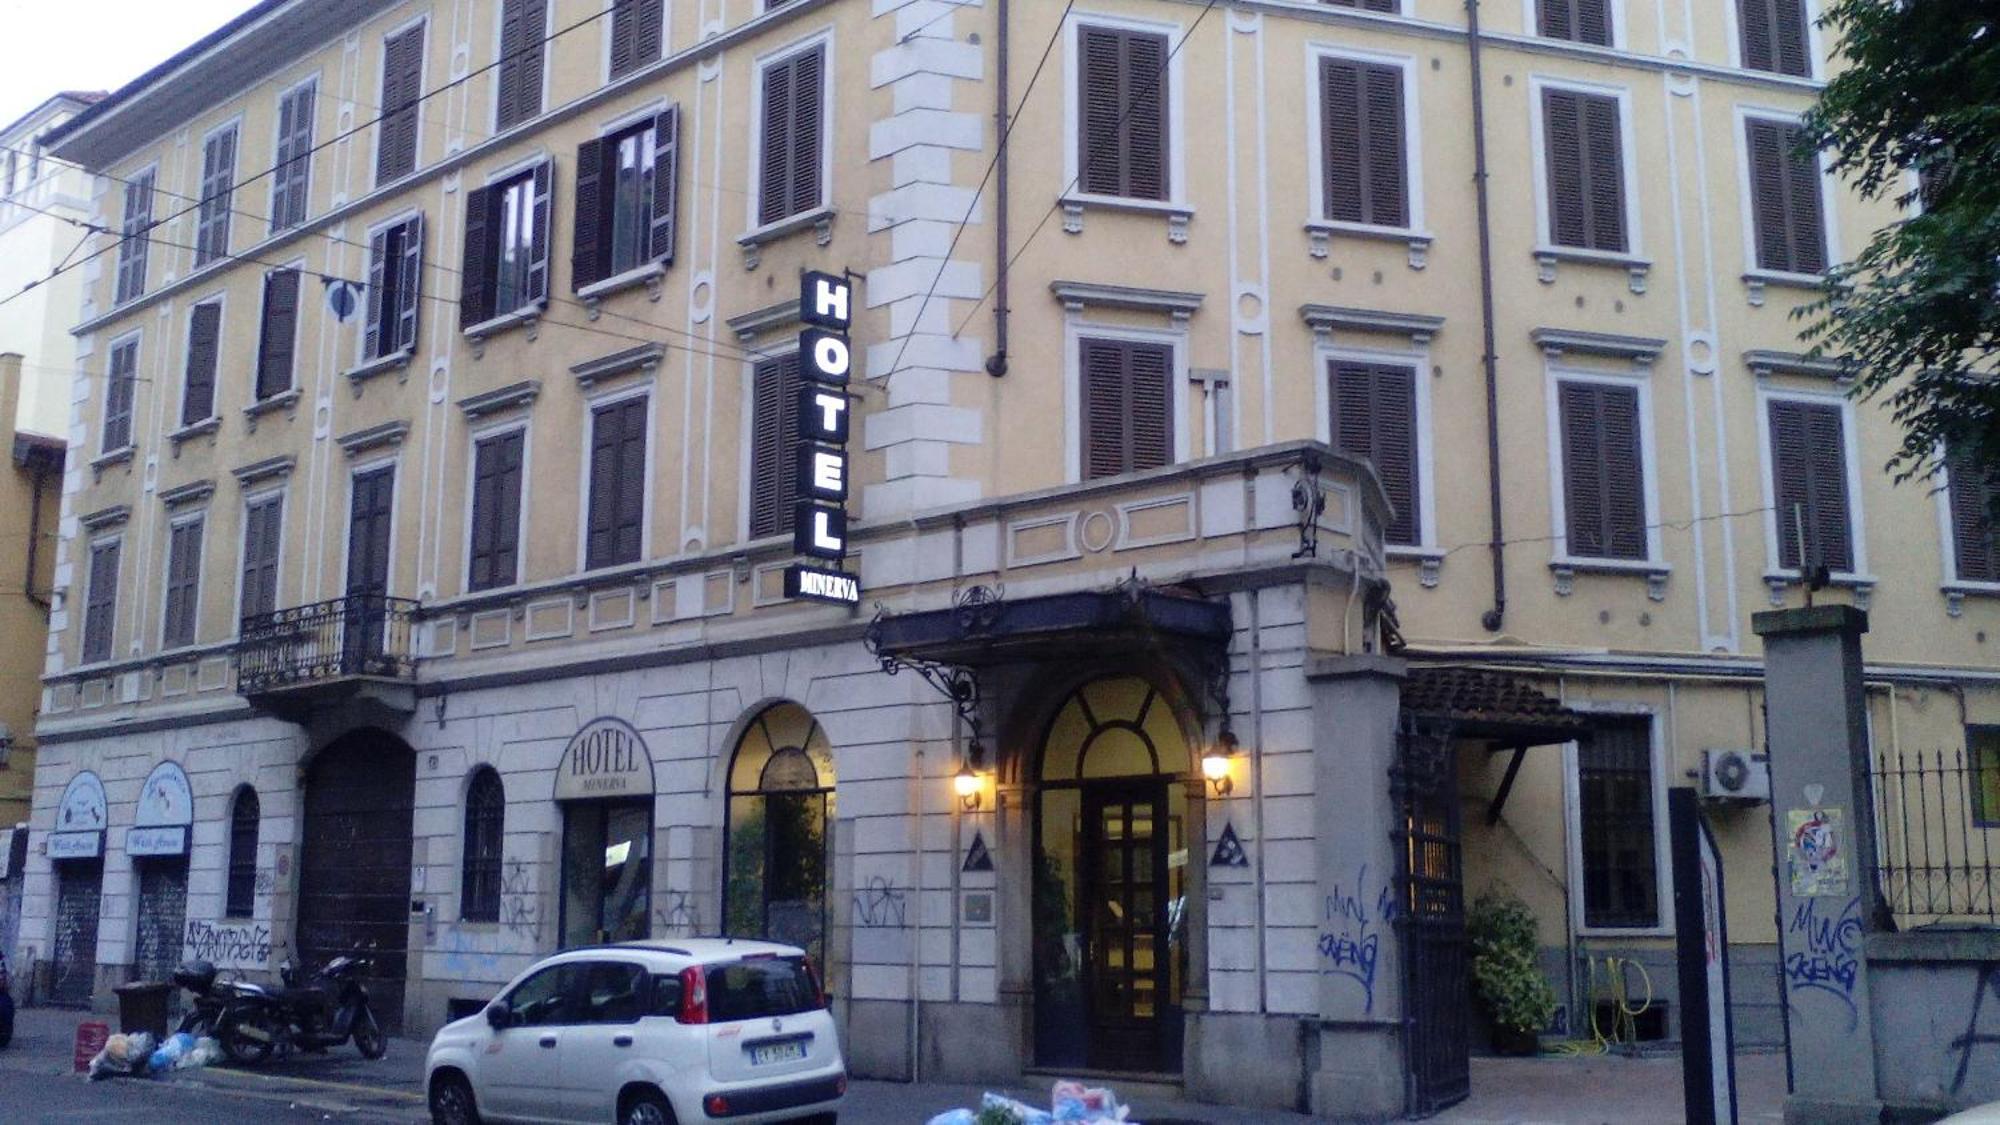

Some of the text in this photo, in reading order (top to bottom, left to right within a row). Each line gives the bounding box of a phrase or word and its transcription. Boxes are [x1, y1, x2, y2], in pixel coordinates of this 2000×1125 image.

[814, 279, 849, 551] HOTEL
[800, 570, 859, 602] MINERVA
[572, 728, 639, 776] HOTEL
